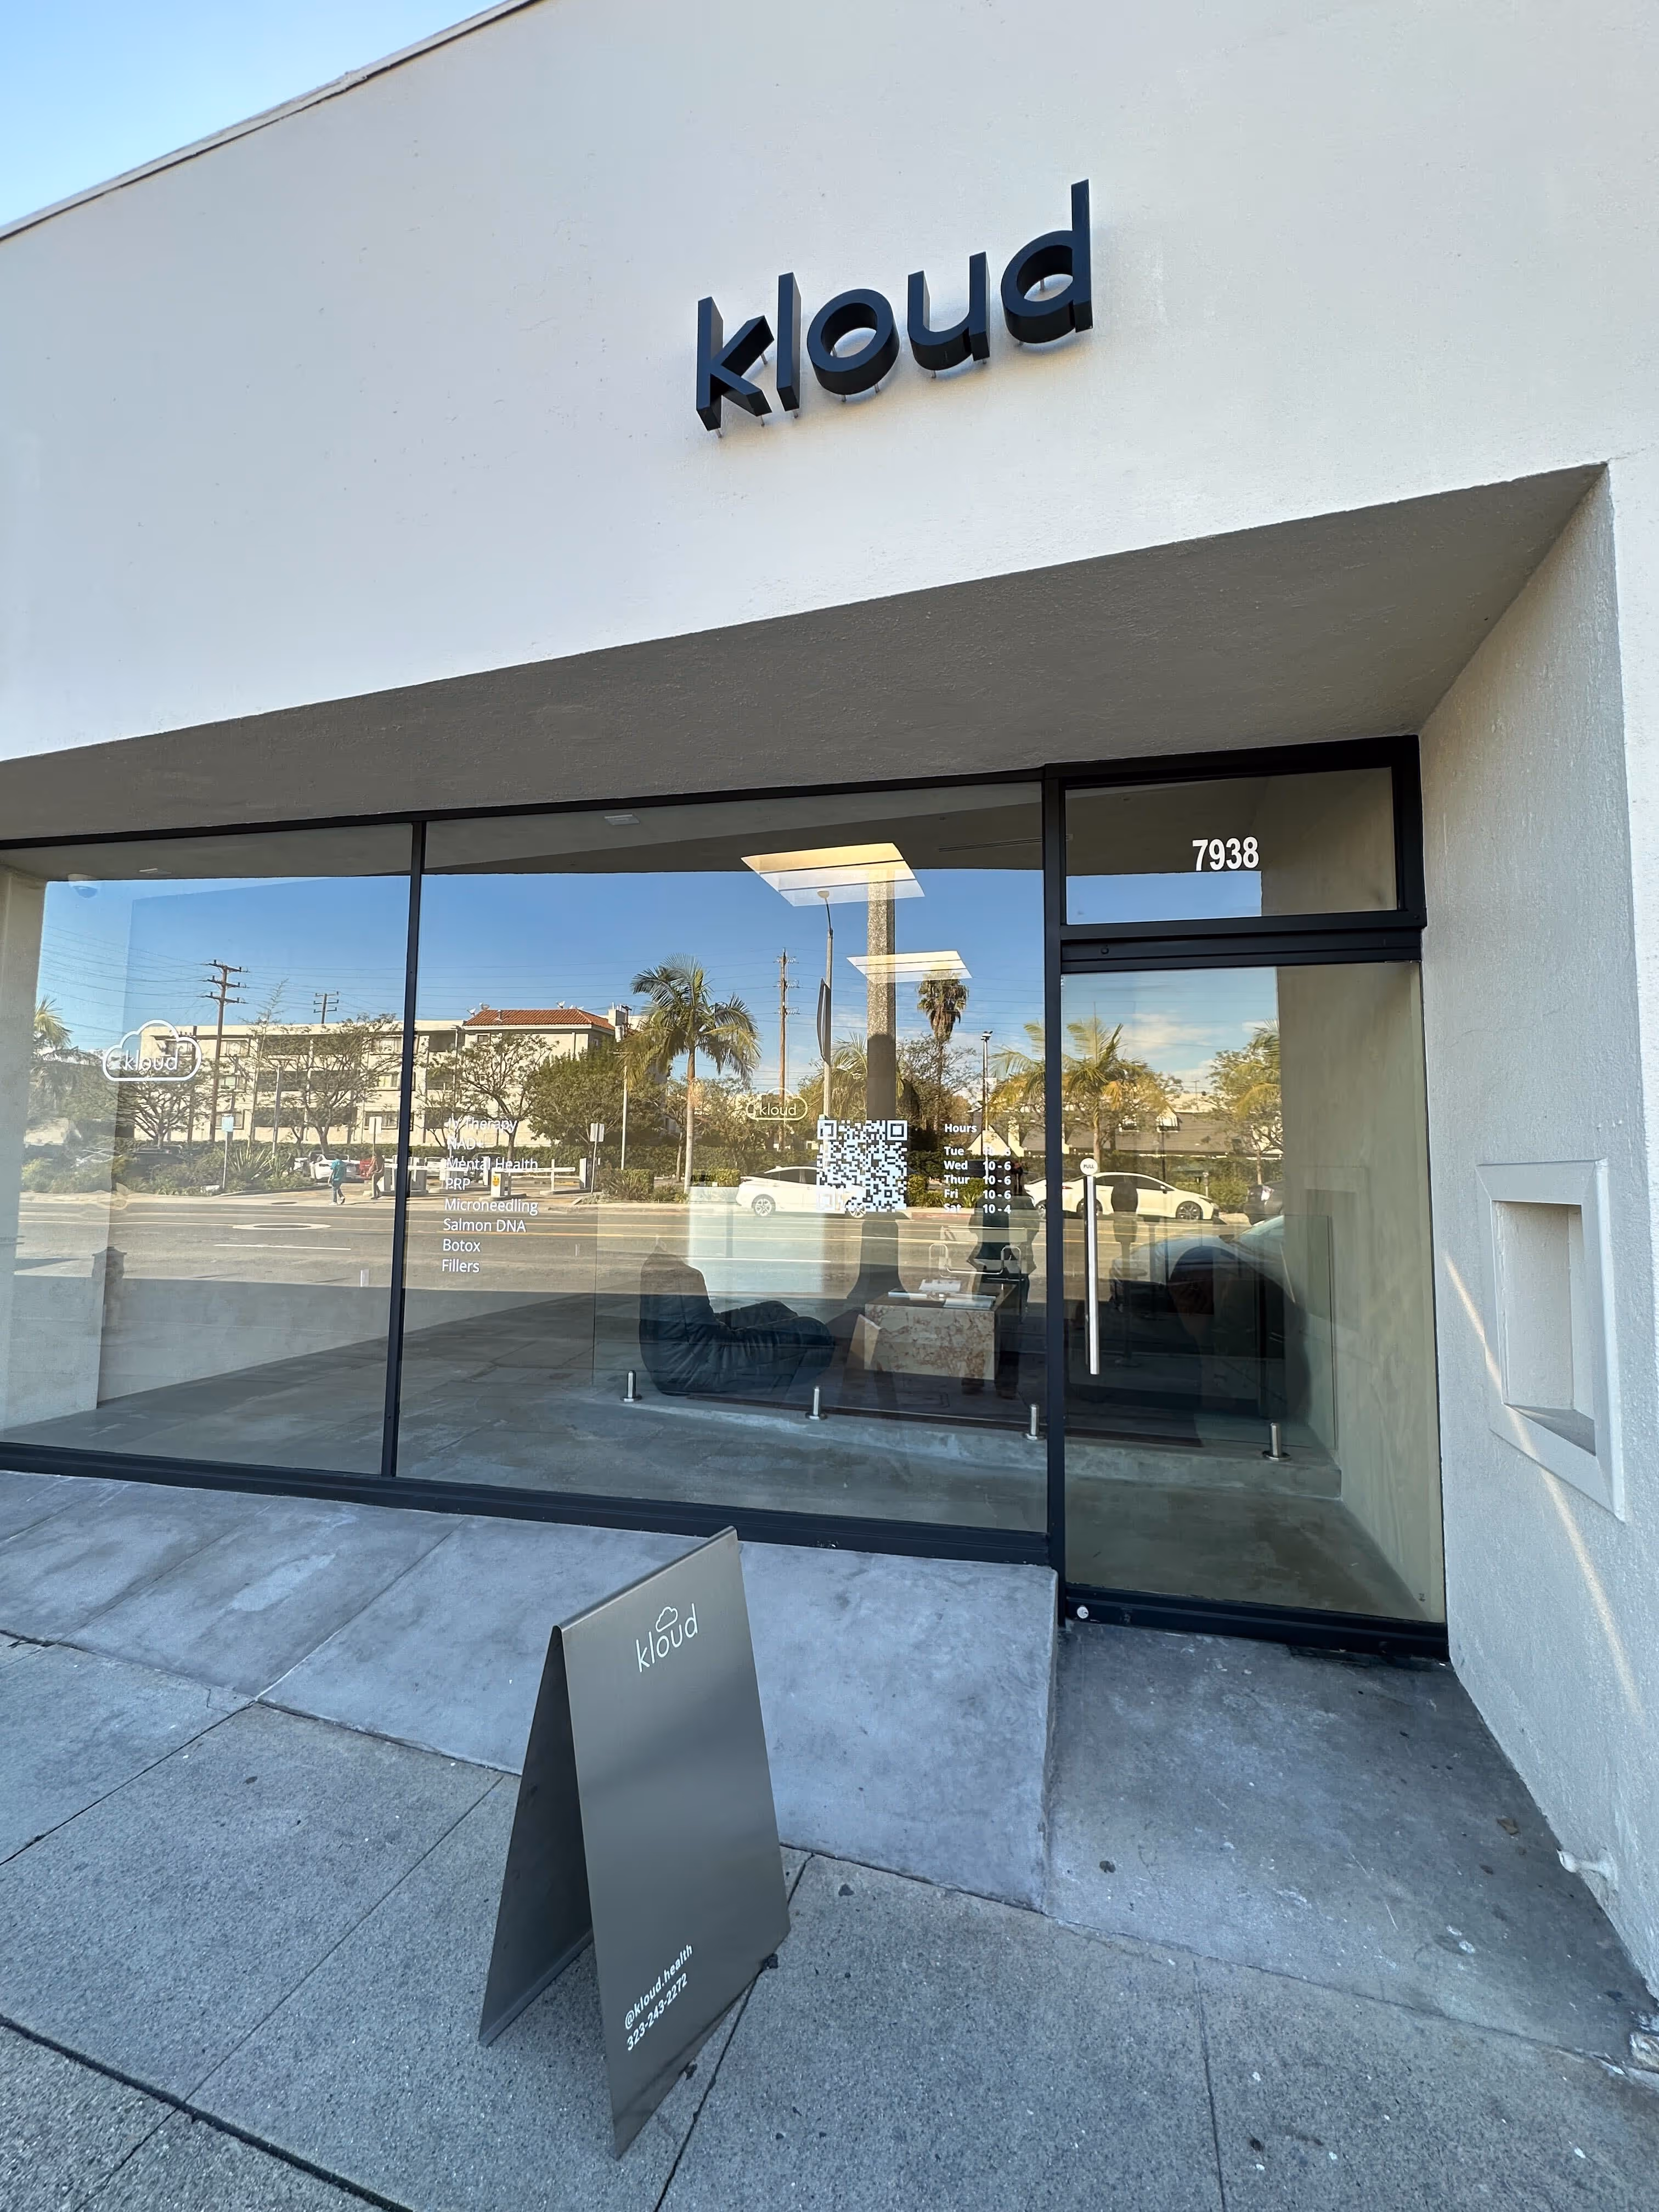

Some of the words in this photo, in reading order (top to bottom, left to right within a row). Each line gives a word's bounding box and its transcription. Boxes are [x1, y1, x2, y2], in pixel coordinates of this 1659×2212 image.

[697, 179, 1093, 431] kloud
[1192, 837, 1259, 871] 7938
[124, 1048, 179, 1071] kloud
[759, 1102, 797, 1116] kloud
[464, 1115, 517, 1133] Therapy
[944, 1123, 977, 1133] Hours
[944, 1146, 964, 1155] Tue
[447, 1156, 491, 1170] Mental
[495, 1157, 538, 1170] Health
[944, 1160, 968, 1170] Wed
[983, 1160, 996, 1170] 10
[1004, 1161, 1011, 1171] 6
[445, 1178, 471, 1190] PRP
[944, 1174, 970, 1184] Thur
[983, 1175, 996, 1185] 10
[1004, 1176, 1011, 1186] 6
[944, 1188, 958, 1199] Fri
[983, 1189, 996, 1199] 10
[1004, 1190, 1011, 1200] 6
[444, 1198, 539, 1216] Microneedling
[944, 1203, 961, 1212] Sat
[983, 1204, 996, 1214] 10
[1004, 1204, 1011, 1214] 4
[443, 1218, 492, 1232] Salmon
[496, 1219, 527, 1233] DNA
[443, 1238, 481, 1252] Botox
[442, 1259, 480, 1273] Fillers
[636, 1603, 698, 1673] kloud
[625, 1944, 692, 2030] @kloud.health
[627, 1973, 687, 2051] 323-243-2272
